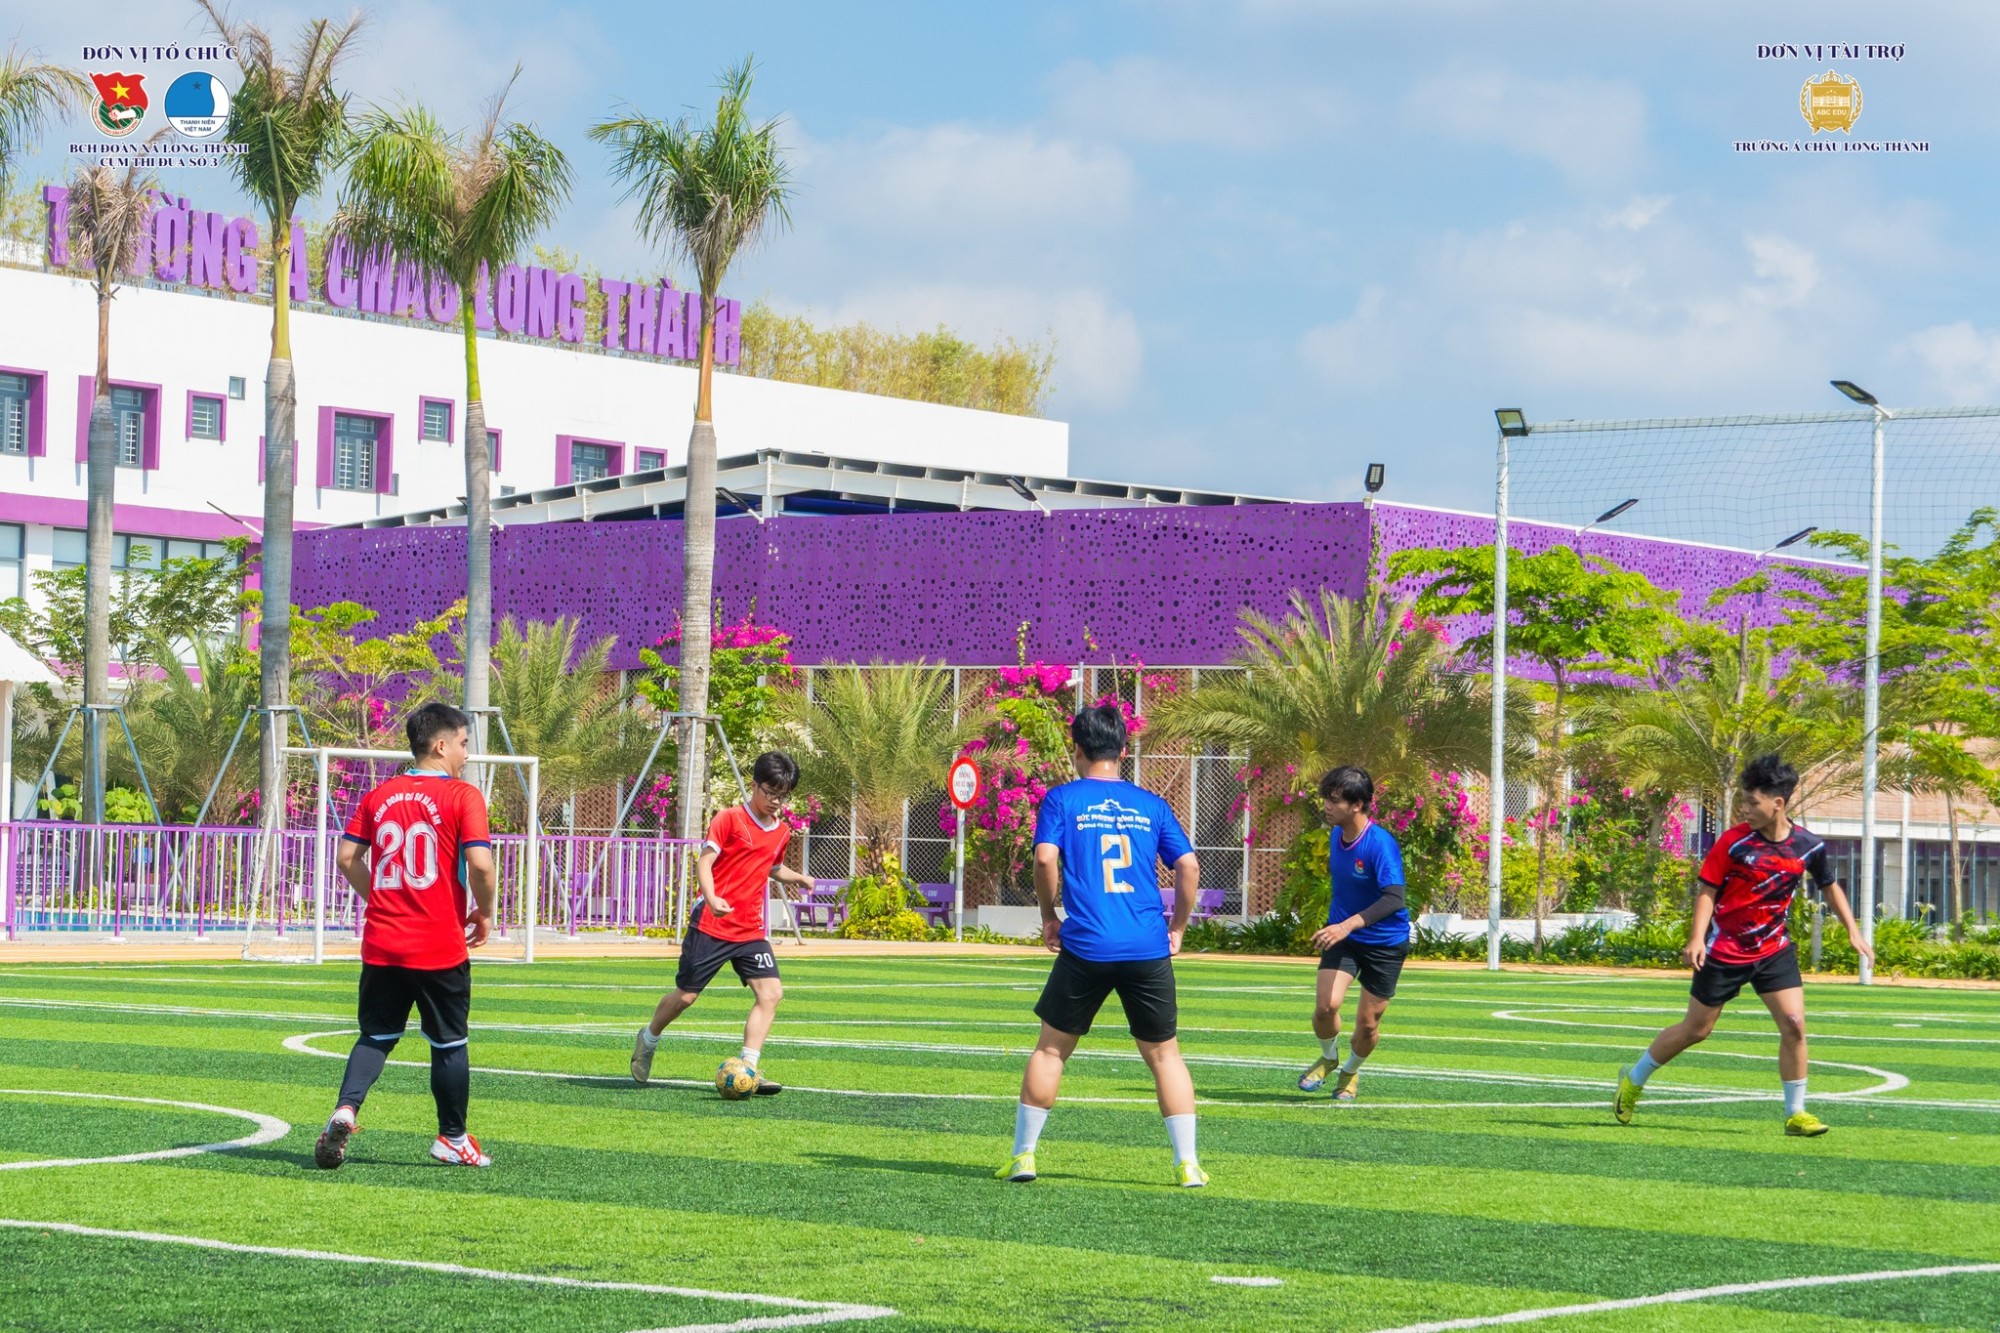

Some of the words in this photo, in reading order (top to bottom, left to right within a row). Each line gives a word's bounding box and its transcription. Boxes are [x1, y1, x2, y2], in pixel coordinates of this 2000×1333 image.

[374, 820, 438, 891] 20
[1100, 834, 1135, 894] 2
[755, 952, 774, 968] 20
